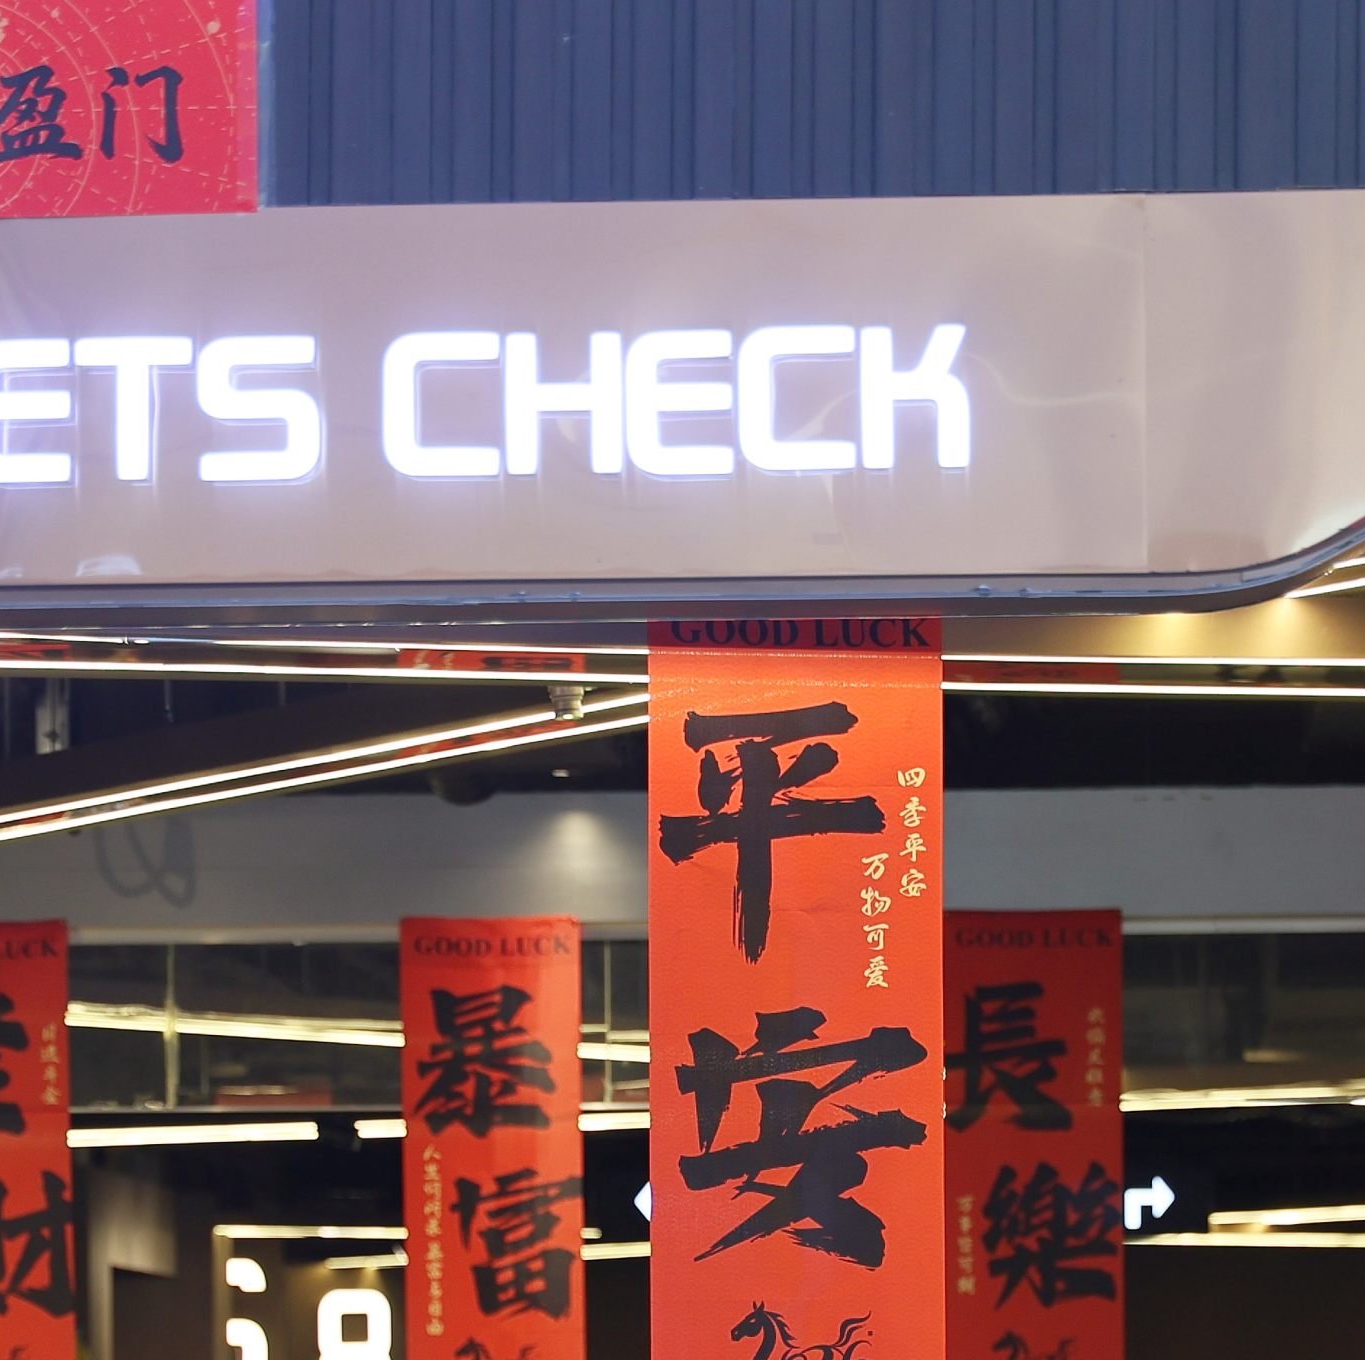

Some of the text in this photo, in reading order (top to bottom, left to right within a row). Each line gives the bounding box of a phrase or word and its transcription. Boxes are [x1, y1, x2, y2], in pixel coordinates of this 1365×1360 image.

[382, 323, 972, 478] CHECK
[670, 619, 931, 648] GOOD LUCK
[898, 767, 926, 896] 四季平安
[414, 936, 572, 957] GOOD LUCK
[659, 701, 928, 1270] 平安
[861, 853, 890, 988] 万物可爱
[956, 928, 1114, 948] GOOD LUCK
[415, 985, 584, 1320] 暴富
